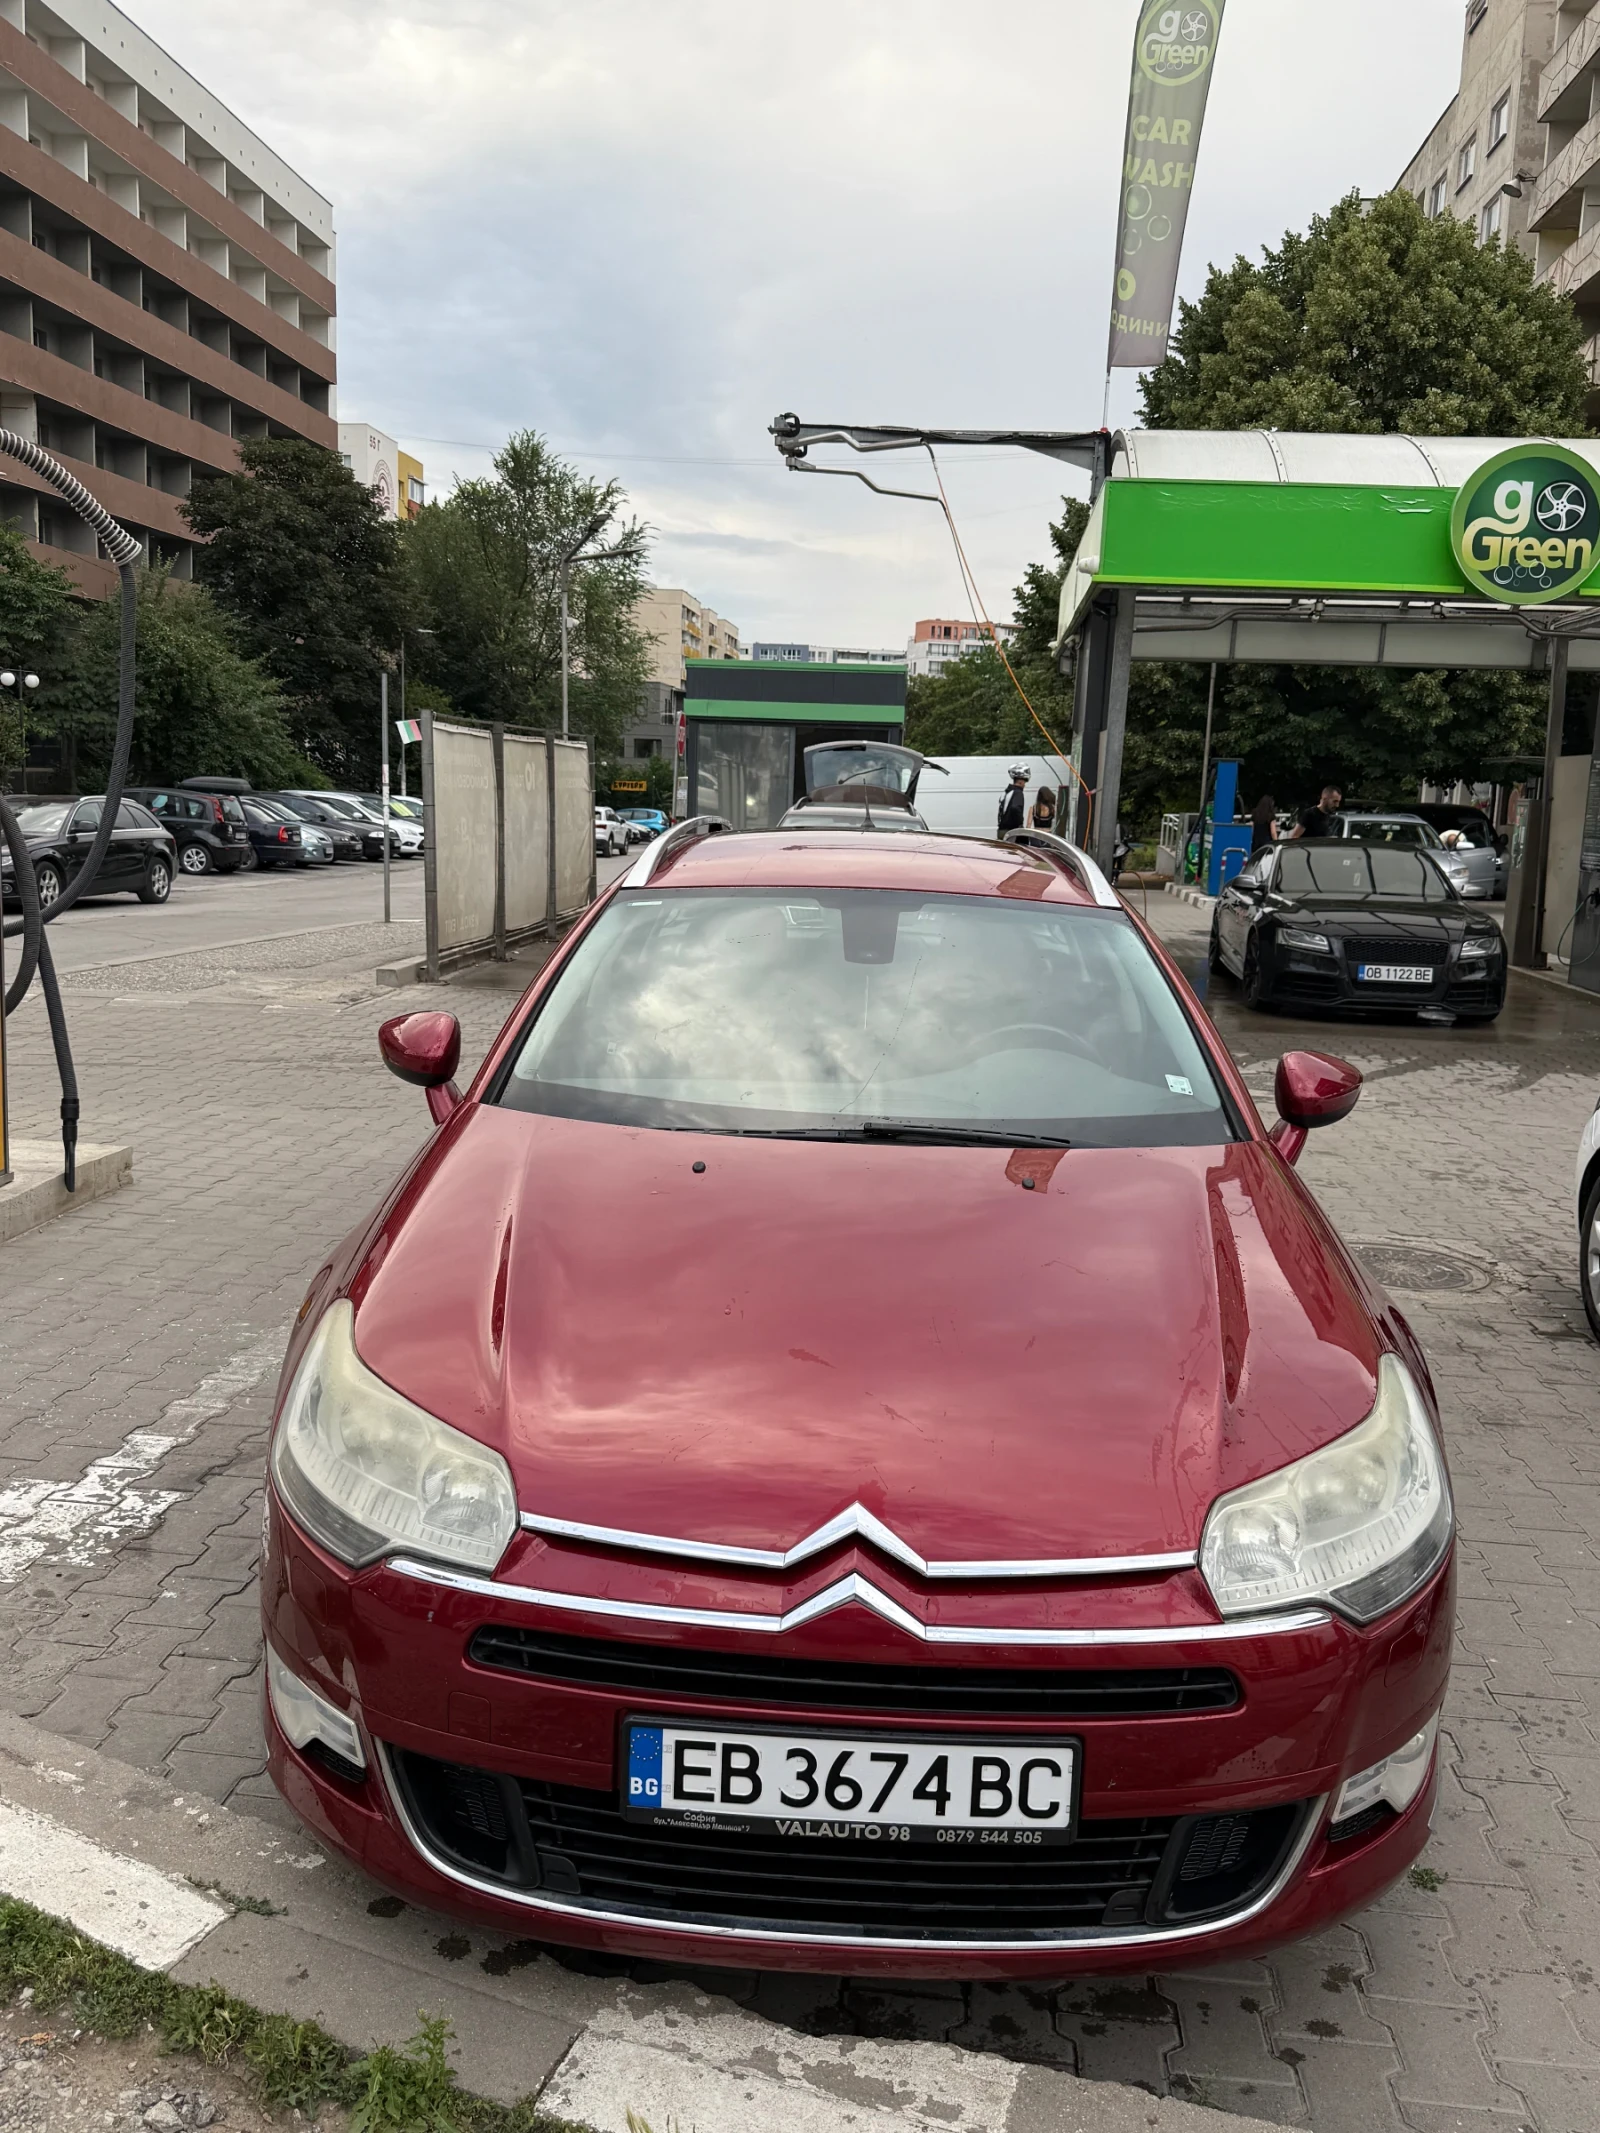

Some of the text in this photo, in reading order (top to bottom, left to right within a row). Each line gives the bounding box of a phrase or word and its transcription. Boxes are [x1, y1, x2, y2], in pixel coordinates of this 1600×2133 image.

[1141, 36, 1209, 66] Green
[1132, 115, 1192, 146] CAR
[1462, 522, 1592, 571] Green
[1366, 967, 1382, 979] OB
[1385, 968, 1413, 980] 1122
[1415, 969, 1431, 981] BE
[630, 1776, 659, 1796] BG
[673, 1739, 1062, 1820] EB 3674 BC
[683, 1811, 716, 1823] София
[775, 1820, 911, 1842] VALAUTO 98
[936, 1828, 1043, 1845] 0879 544 505
